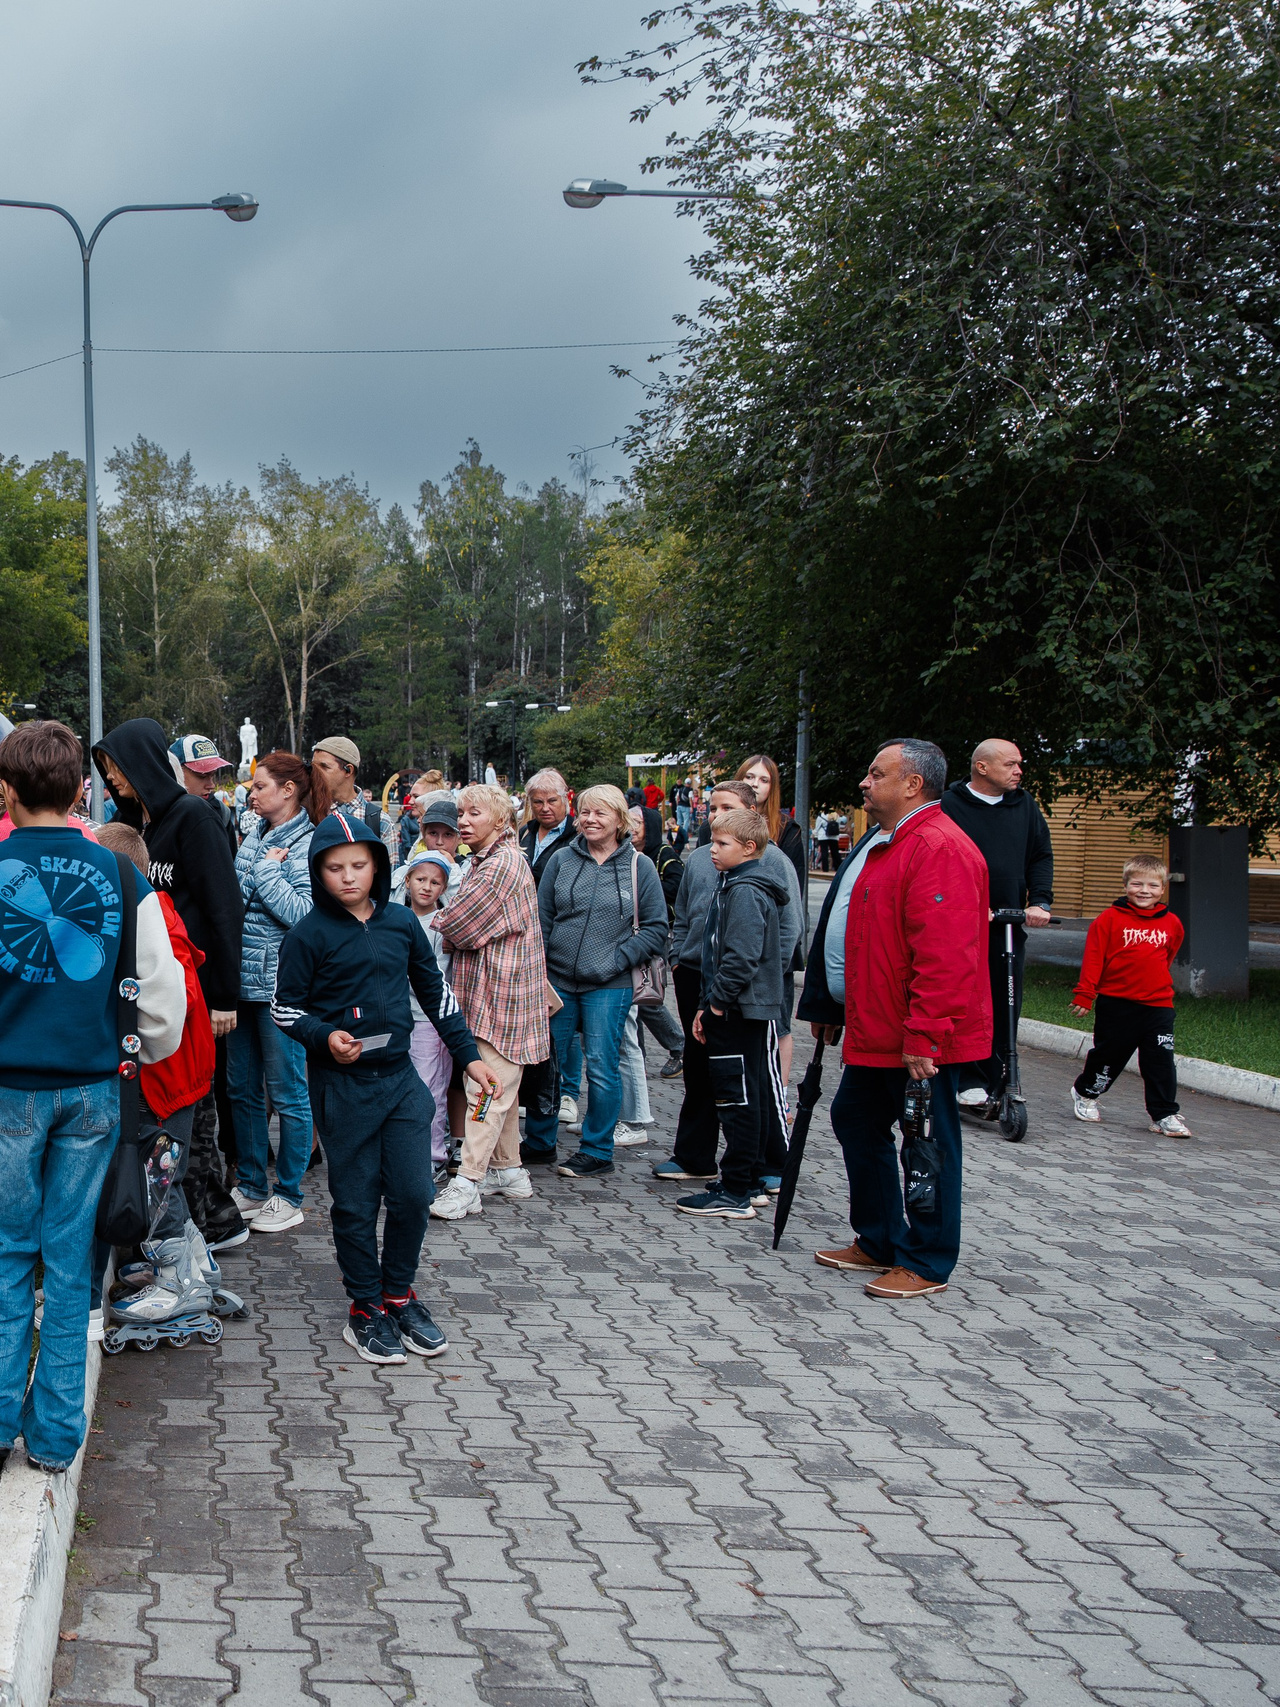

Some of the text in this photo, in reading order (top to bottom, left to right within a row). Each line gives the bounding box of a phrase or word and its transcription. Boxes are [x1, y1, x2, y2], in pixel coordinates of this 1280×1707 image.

[40, 856, 119, 907] SKATERS
[100, 911, 121, 938] ON
[1122, 927, 1168, 948] DREAM
[20, 964, 56, 983] THE
